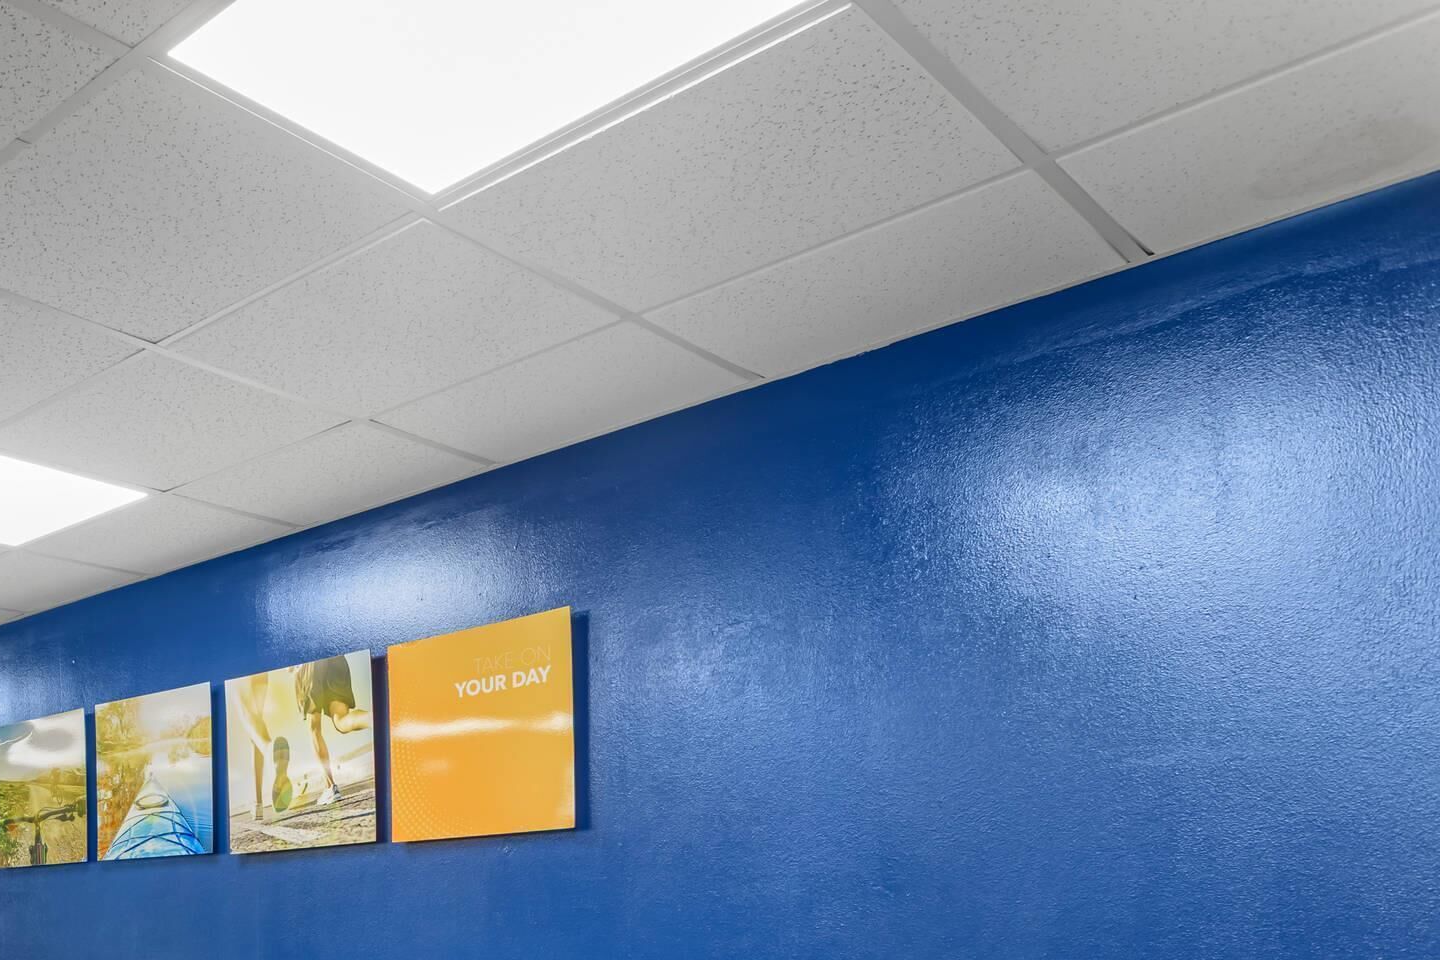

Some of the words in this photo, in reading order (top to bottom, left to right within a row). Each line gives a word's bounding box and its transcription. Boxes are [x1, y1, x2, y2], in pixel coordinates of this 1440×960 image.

[472, 650, 513, 675] TAKE
[521, 643, 551, 666] ON
[454, 674, 507, 698] YOUR
[512, 664, 551, 688] DAY
